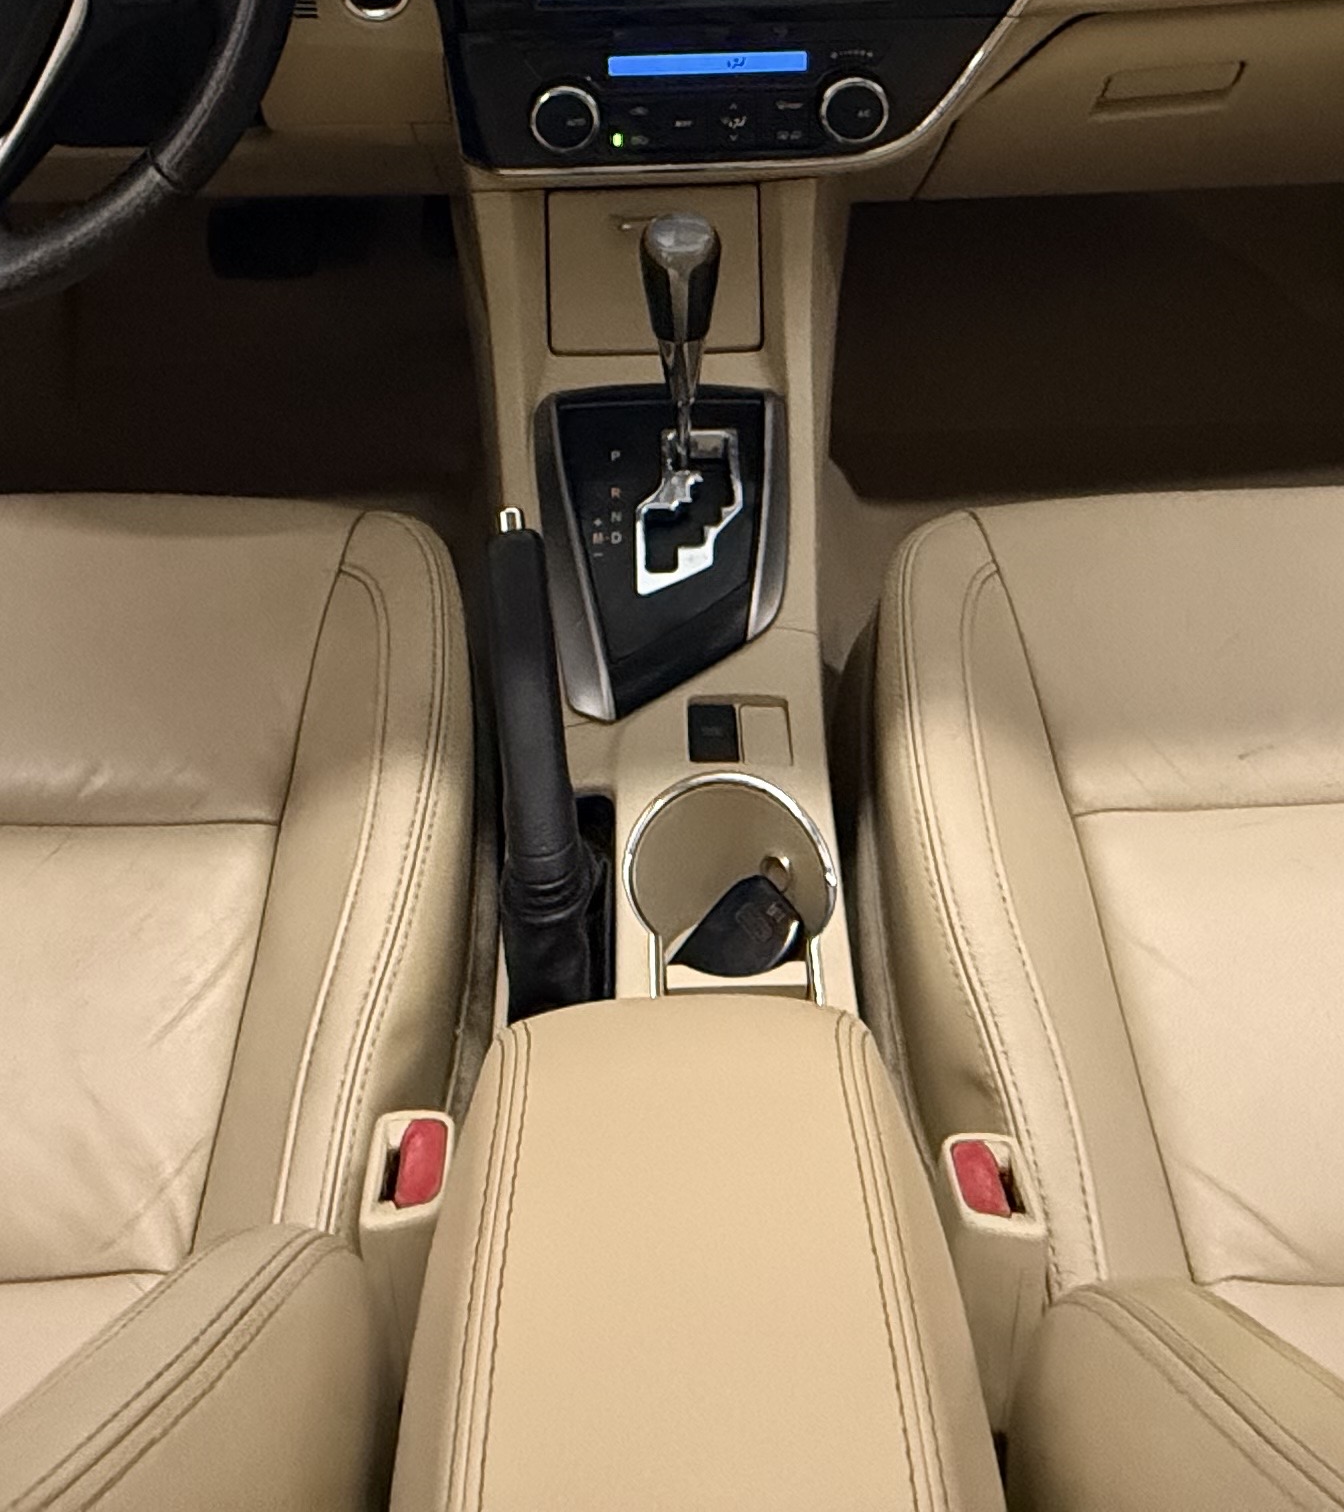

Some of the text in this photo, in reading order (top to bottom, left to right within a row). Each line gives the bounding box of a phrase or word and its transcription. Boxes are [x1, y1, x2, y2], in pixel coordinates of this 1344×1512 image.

[611, 451, 620, 461] P
[611, 488, 621, 498] R
[611, 512, 621, 522] N
[611, 532, 621, 543] D
